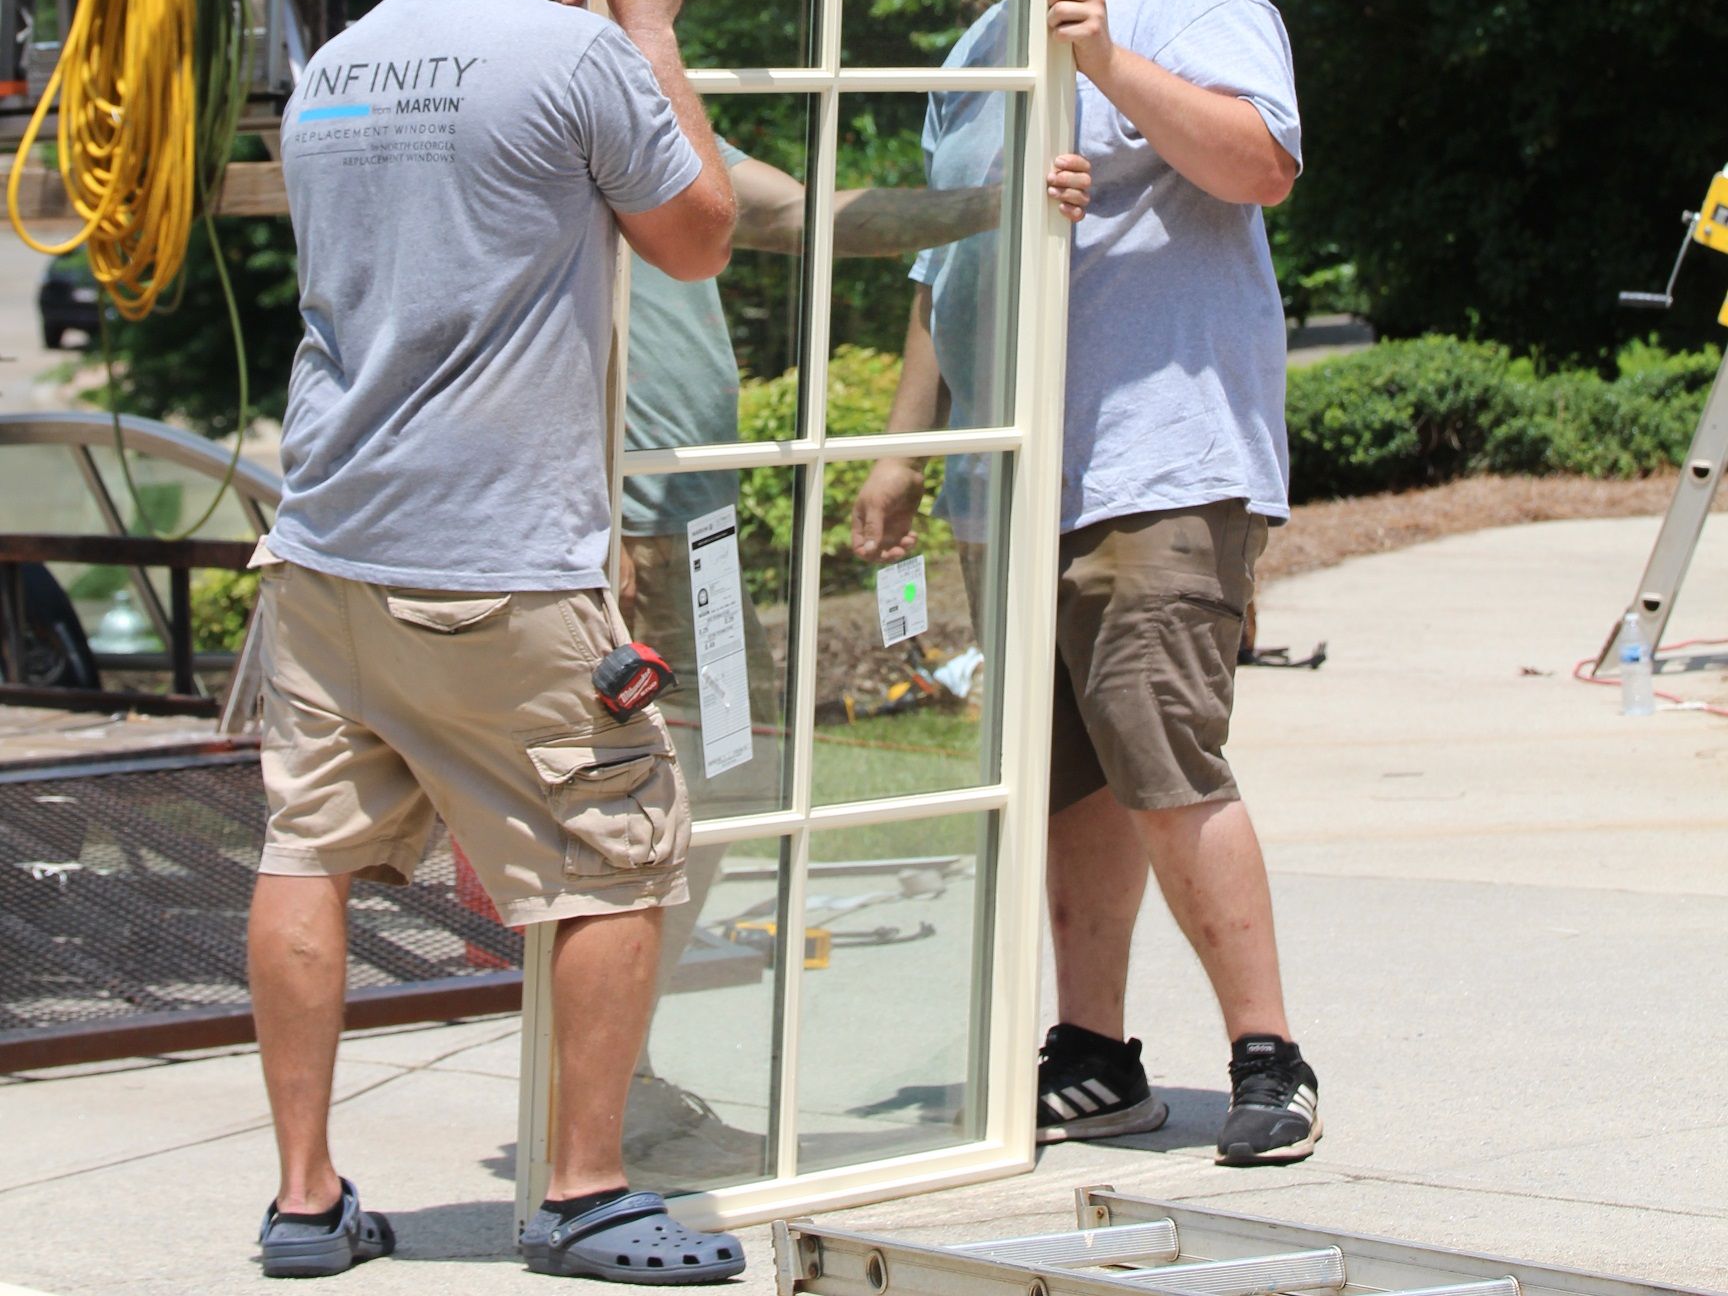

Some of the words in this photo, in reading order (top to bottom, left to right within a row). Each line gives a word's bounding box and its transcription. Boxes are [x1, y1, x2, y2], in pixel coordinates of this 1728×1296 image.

[303, 56, 478, 100] INFINITY
[372, 105, 392, 115] from
[395, 97, 460, 115] MARVIN
[295, 126, 388, 143] REPLACEMENT
[394, 124, 456, 135] WINDOWS
[380, 142, 411, 151] NORTH
[413, 141, 455, 151] GEORGIA
[342, 154, 403, 166] REPLACEMENT
[406, 152, 455, 163] WINDOWS
